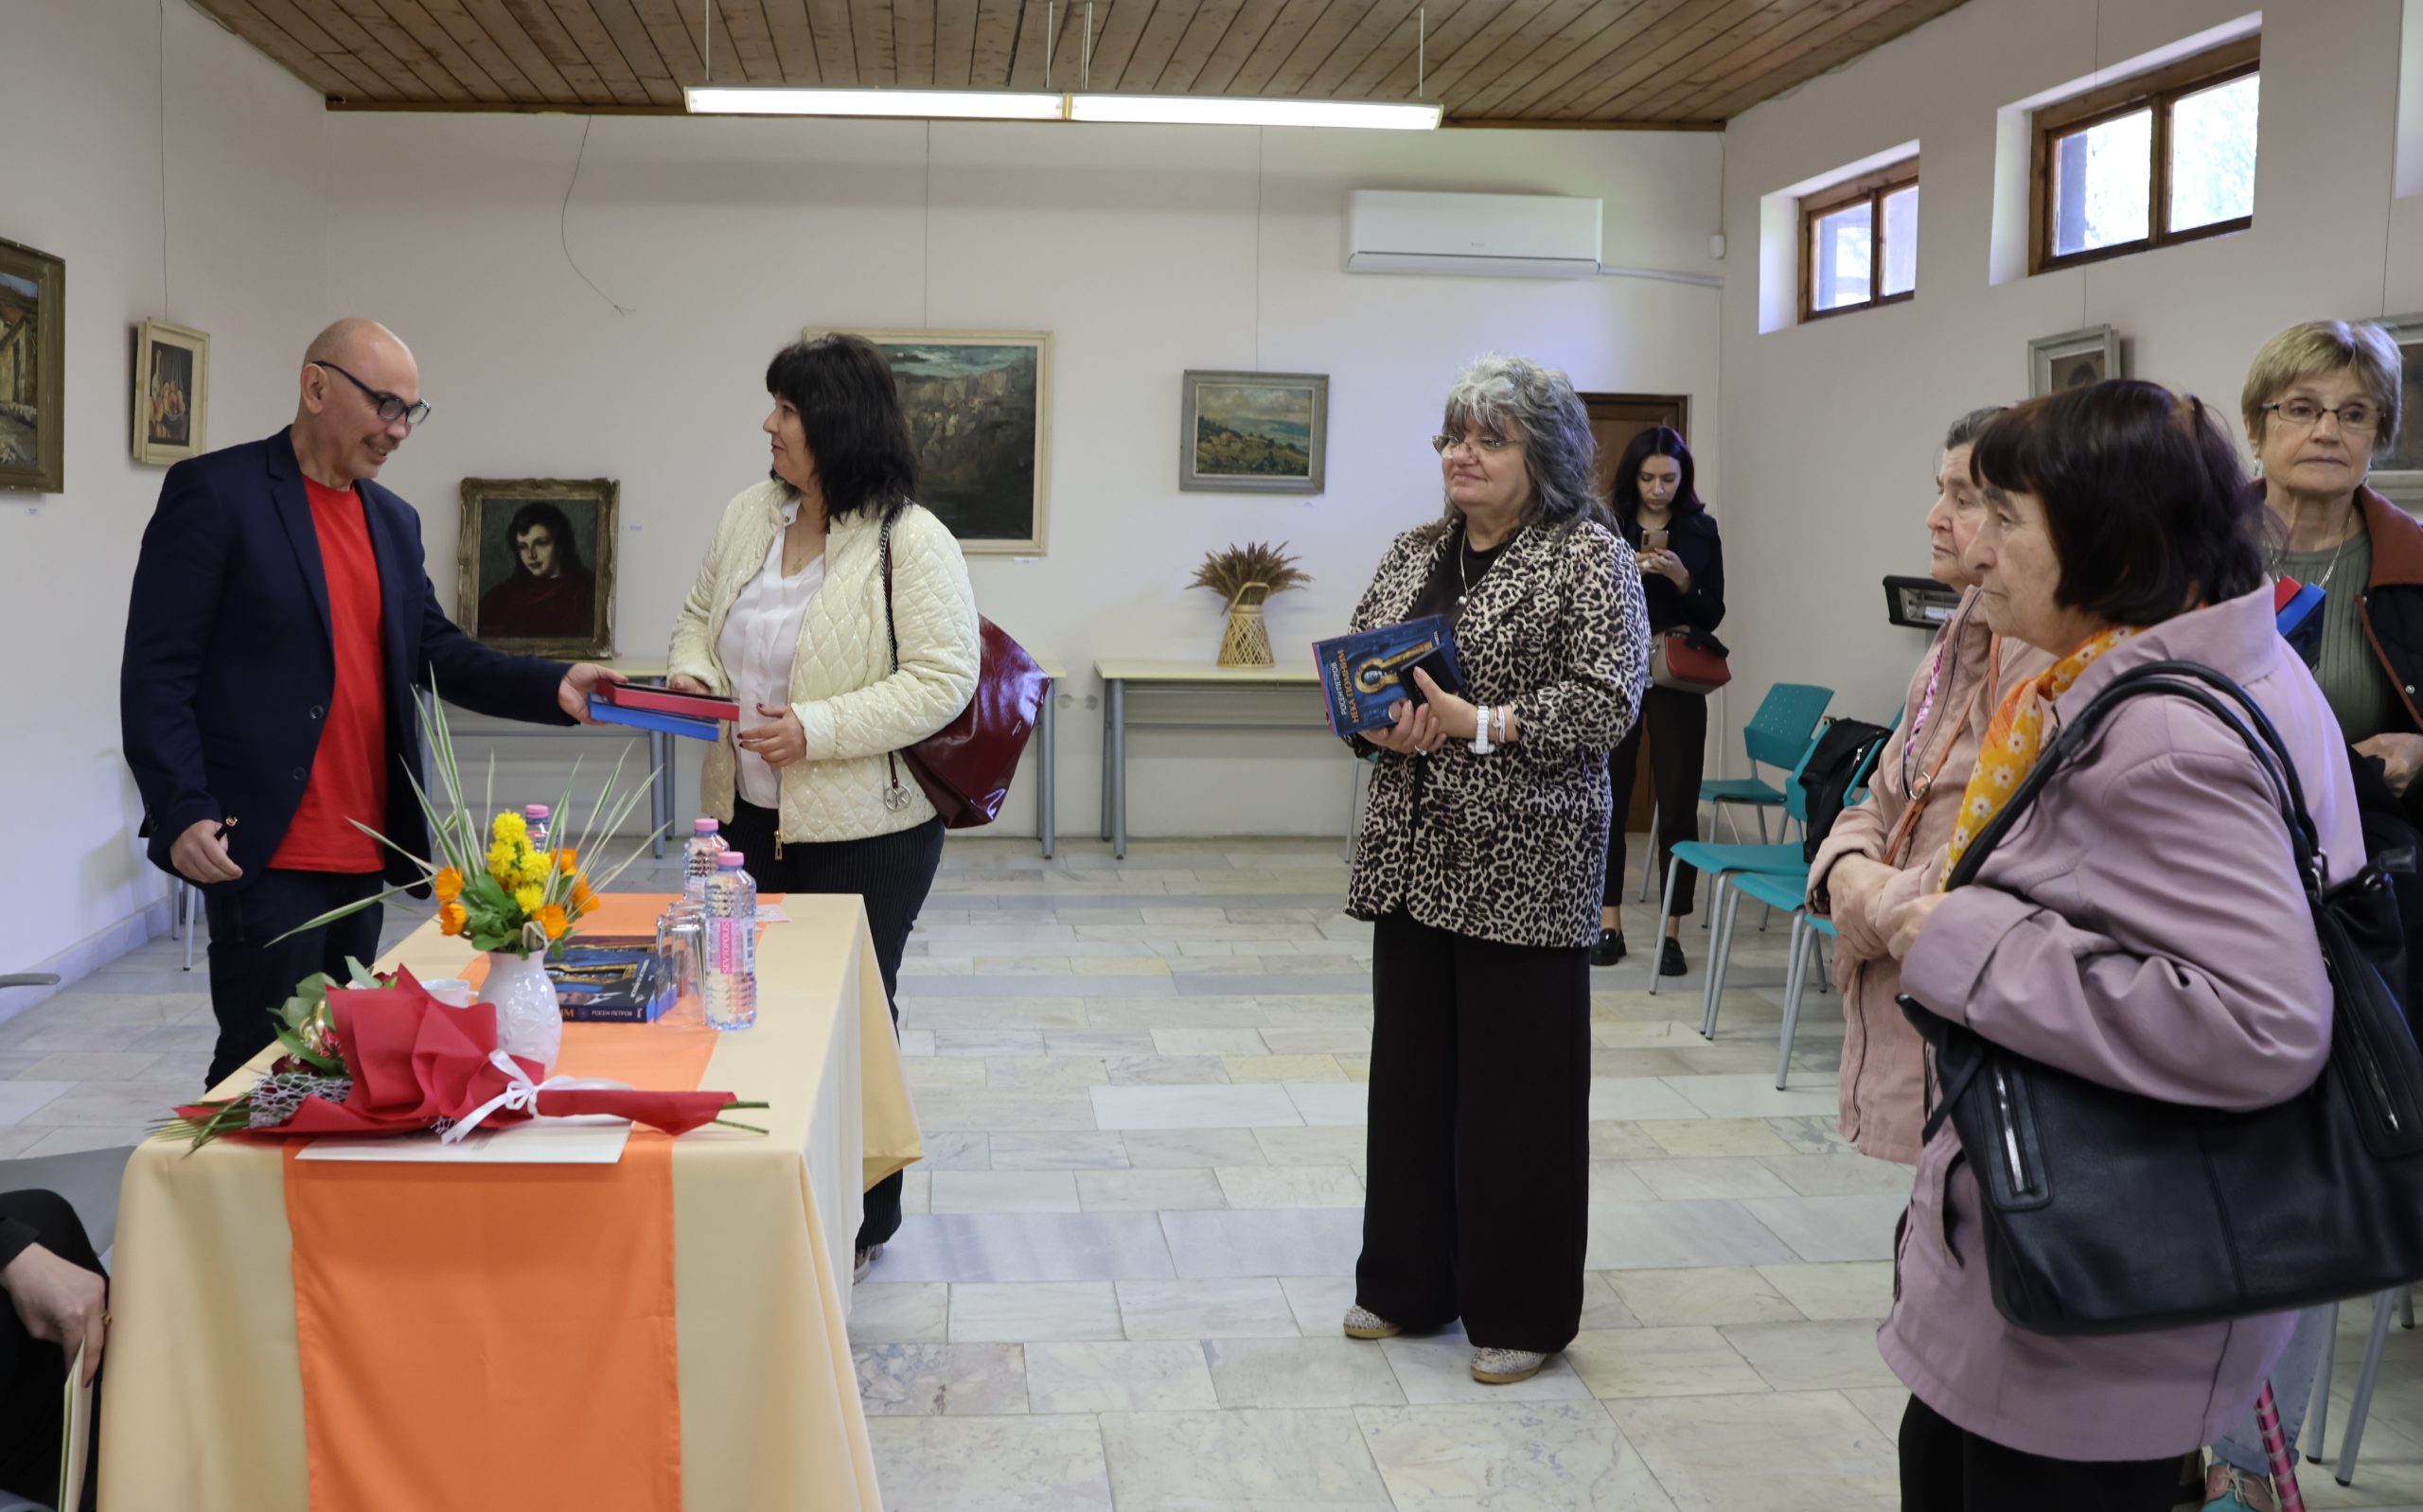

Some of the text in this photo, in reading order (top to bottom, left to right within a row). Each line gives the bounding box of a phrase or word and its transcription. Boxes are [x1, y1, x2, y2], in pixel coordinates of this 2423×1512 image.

[1331, 661, 1348, 715] РОСЕН ПЕТРОВ
[1336, 649, 1360, 723] НЕКА ПОМНИМ
[722, 923, 731, 973] SEVTOPOLIS
